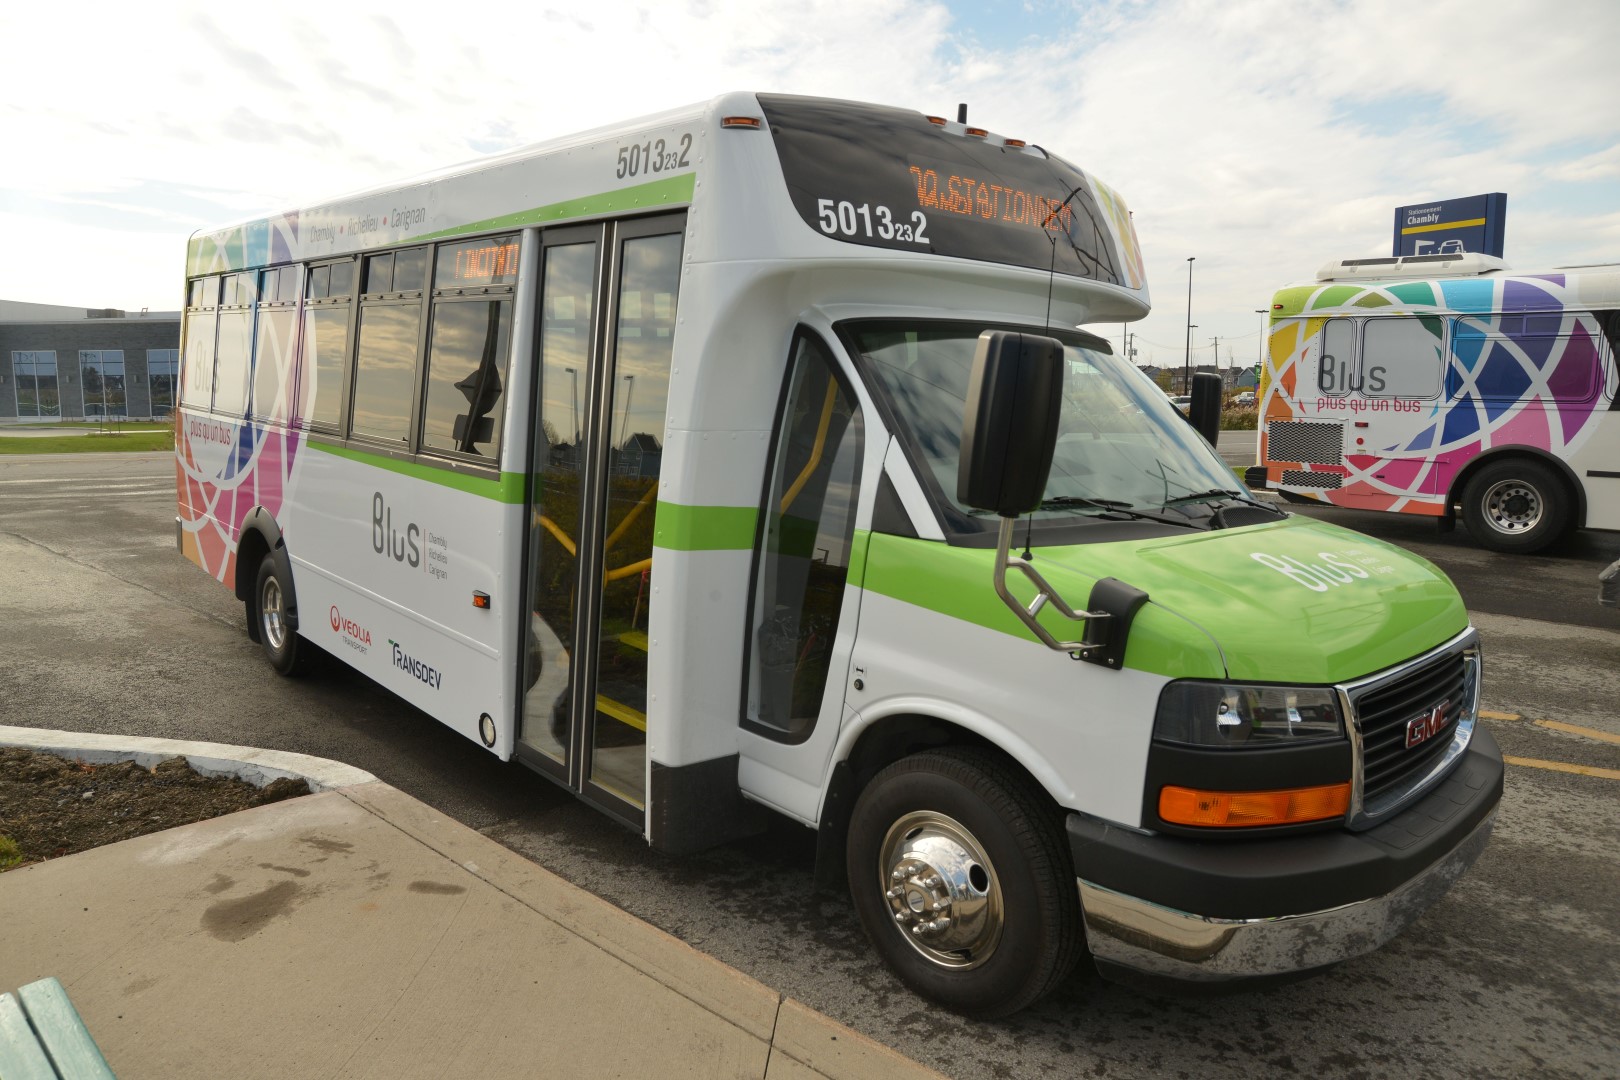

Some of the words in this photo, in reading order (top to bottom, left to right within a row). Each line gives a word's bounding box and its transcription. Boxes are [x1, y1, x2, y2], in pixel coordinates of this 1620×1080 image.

[310, 221, 336, 244] Chambly
[348, 213, 379, 237] Richelieu
[391, 206, 426, 231] Carignan
[1407, 213, 1440, 225] Chambly
[1317, 396, 1346, 413] plus
[1393, 397, 1421, 413] bus
[190, 418, 202, 440] plus
[219, 421, 231, 445] bus
[341, 617, 372, 647] VEOLIA
[342, 635, 368, 655] TRANSPORT
[388, 639, 442, 690] TRANSDEV
[1406, 699, 1450, 750] GMC
